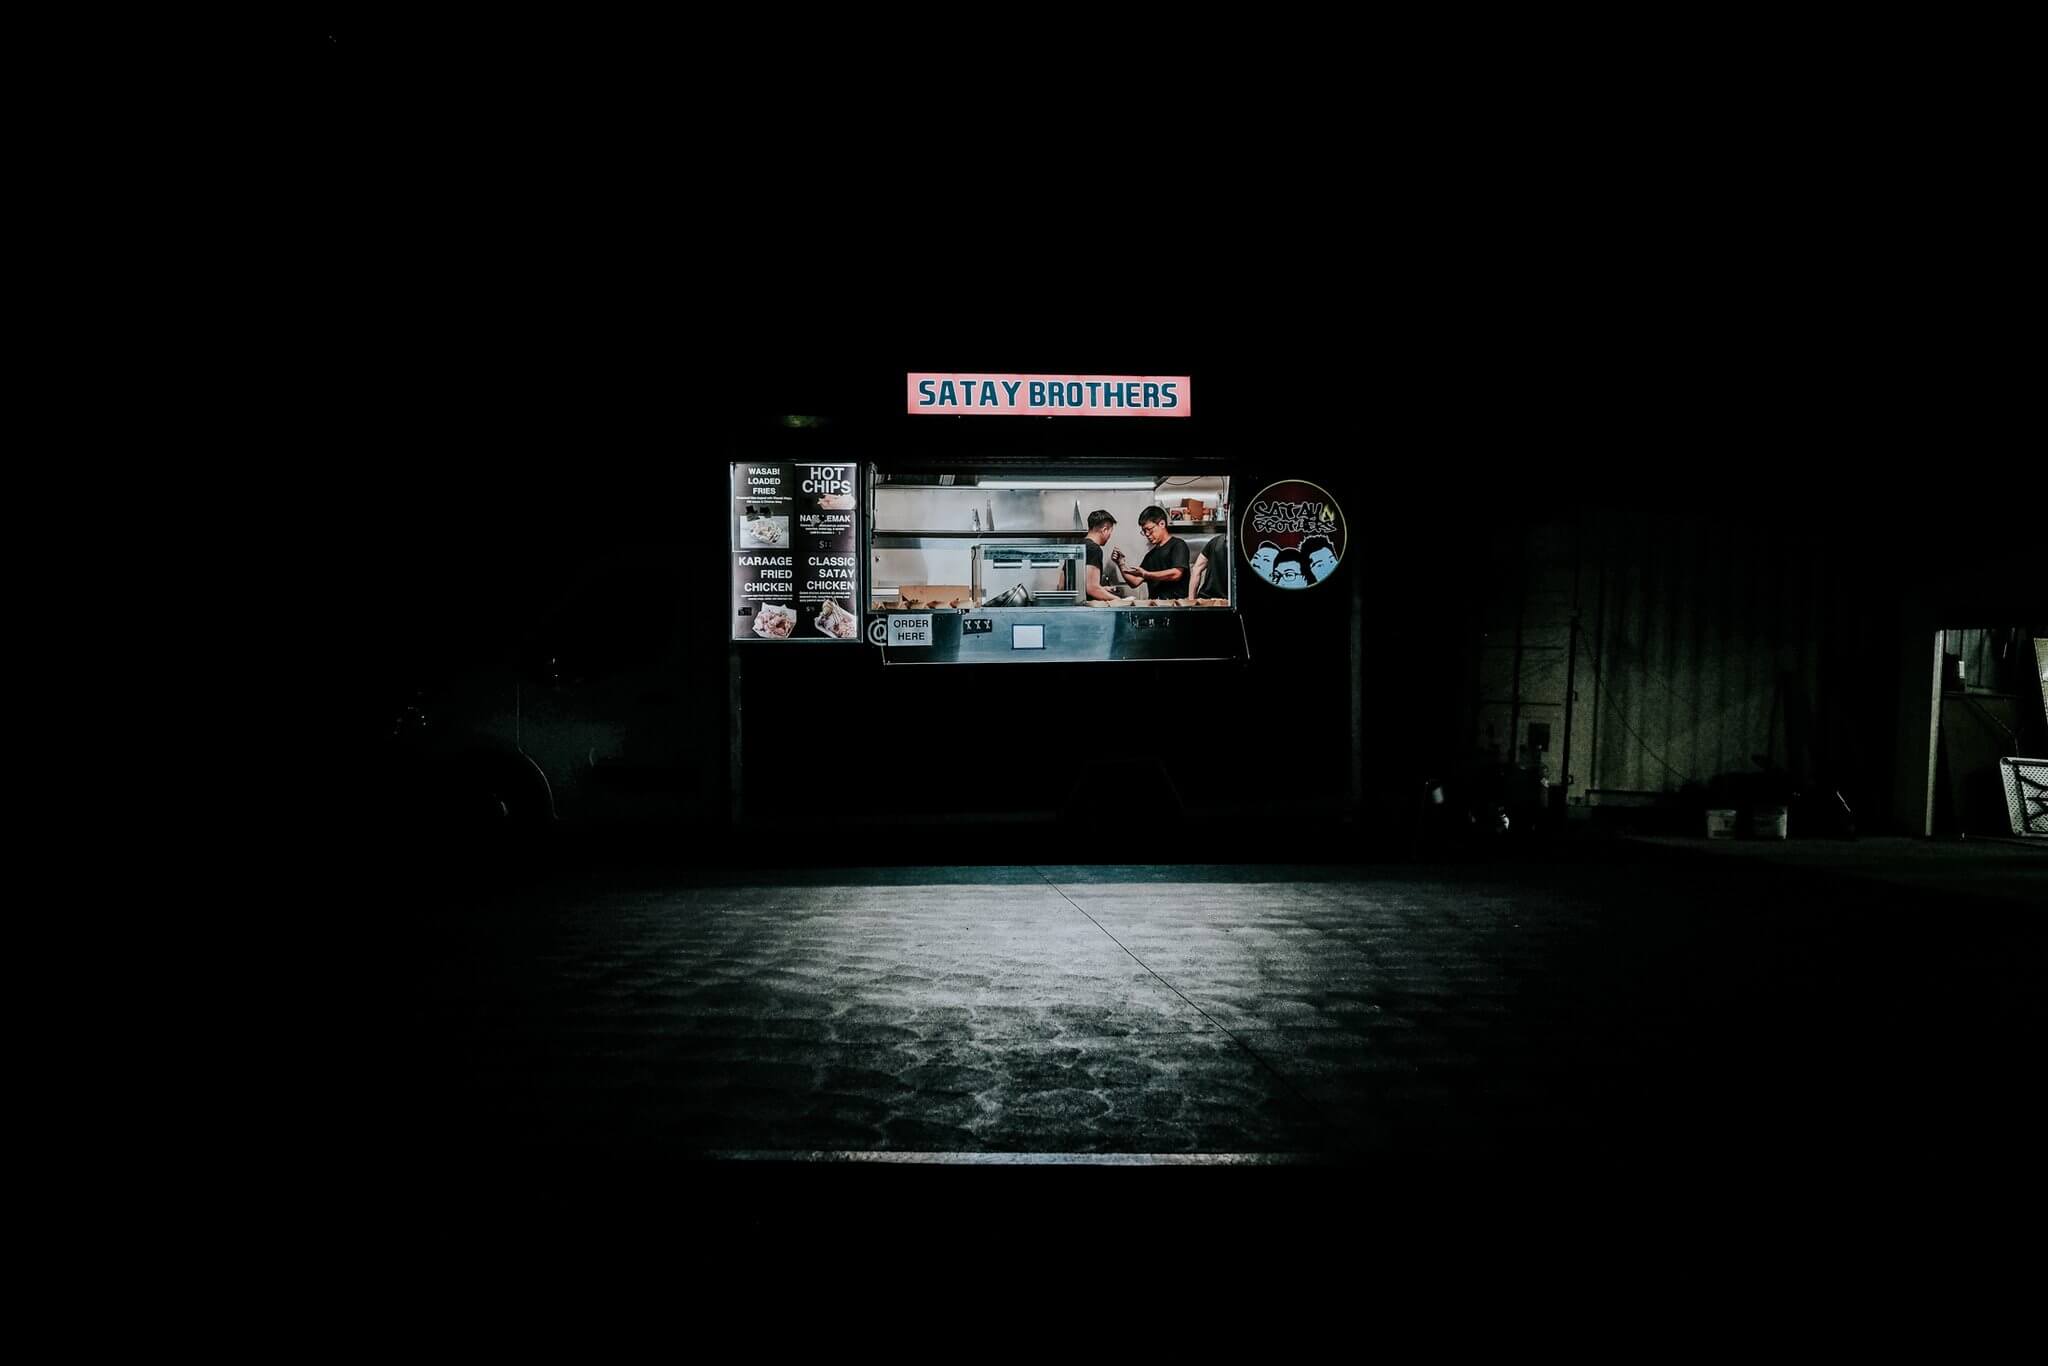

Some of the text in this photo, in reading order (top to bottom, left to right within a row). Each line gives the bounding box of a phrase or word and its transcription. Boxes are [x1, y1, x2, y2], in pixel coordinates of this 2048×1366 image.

[919, 380, 1178, 408] SATAY BROTHERS
[810, 467, 845, 480] HOT
[802, 480, 852, 494] CHIPS
[738, 556, 793, 566] KARAAGE
[808, 556, 855, 566] CLASSIC
[760, 570, 793, 579] FRIED
[819, 569, 855, 578] SATAY
[744, 583, 793, 592] CHICKEN
[806, 581, 855, 590] CHICKEN
[893, 619, 929, 628] ORDER
[898, 632, 925, 641] HERE
